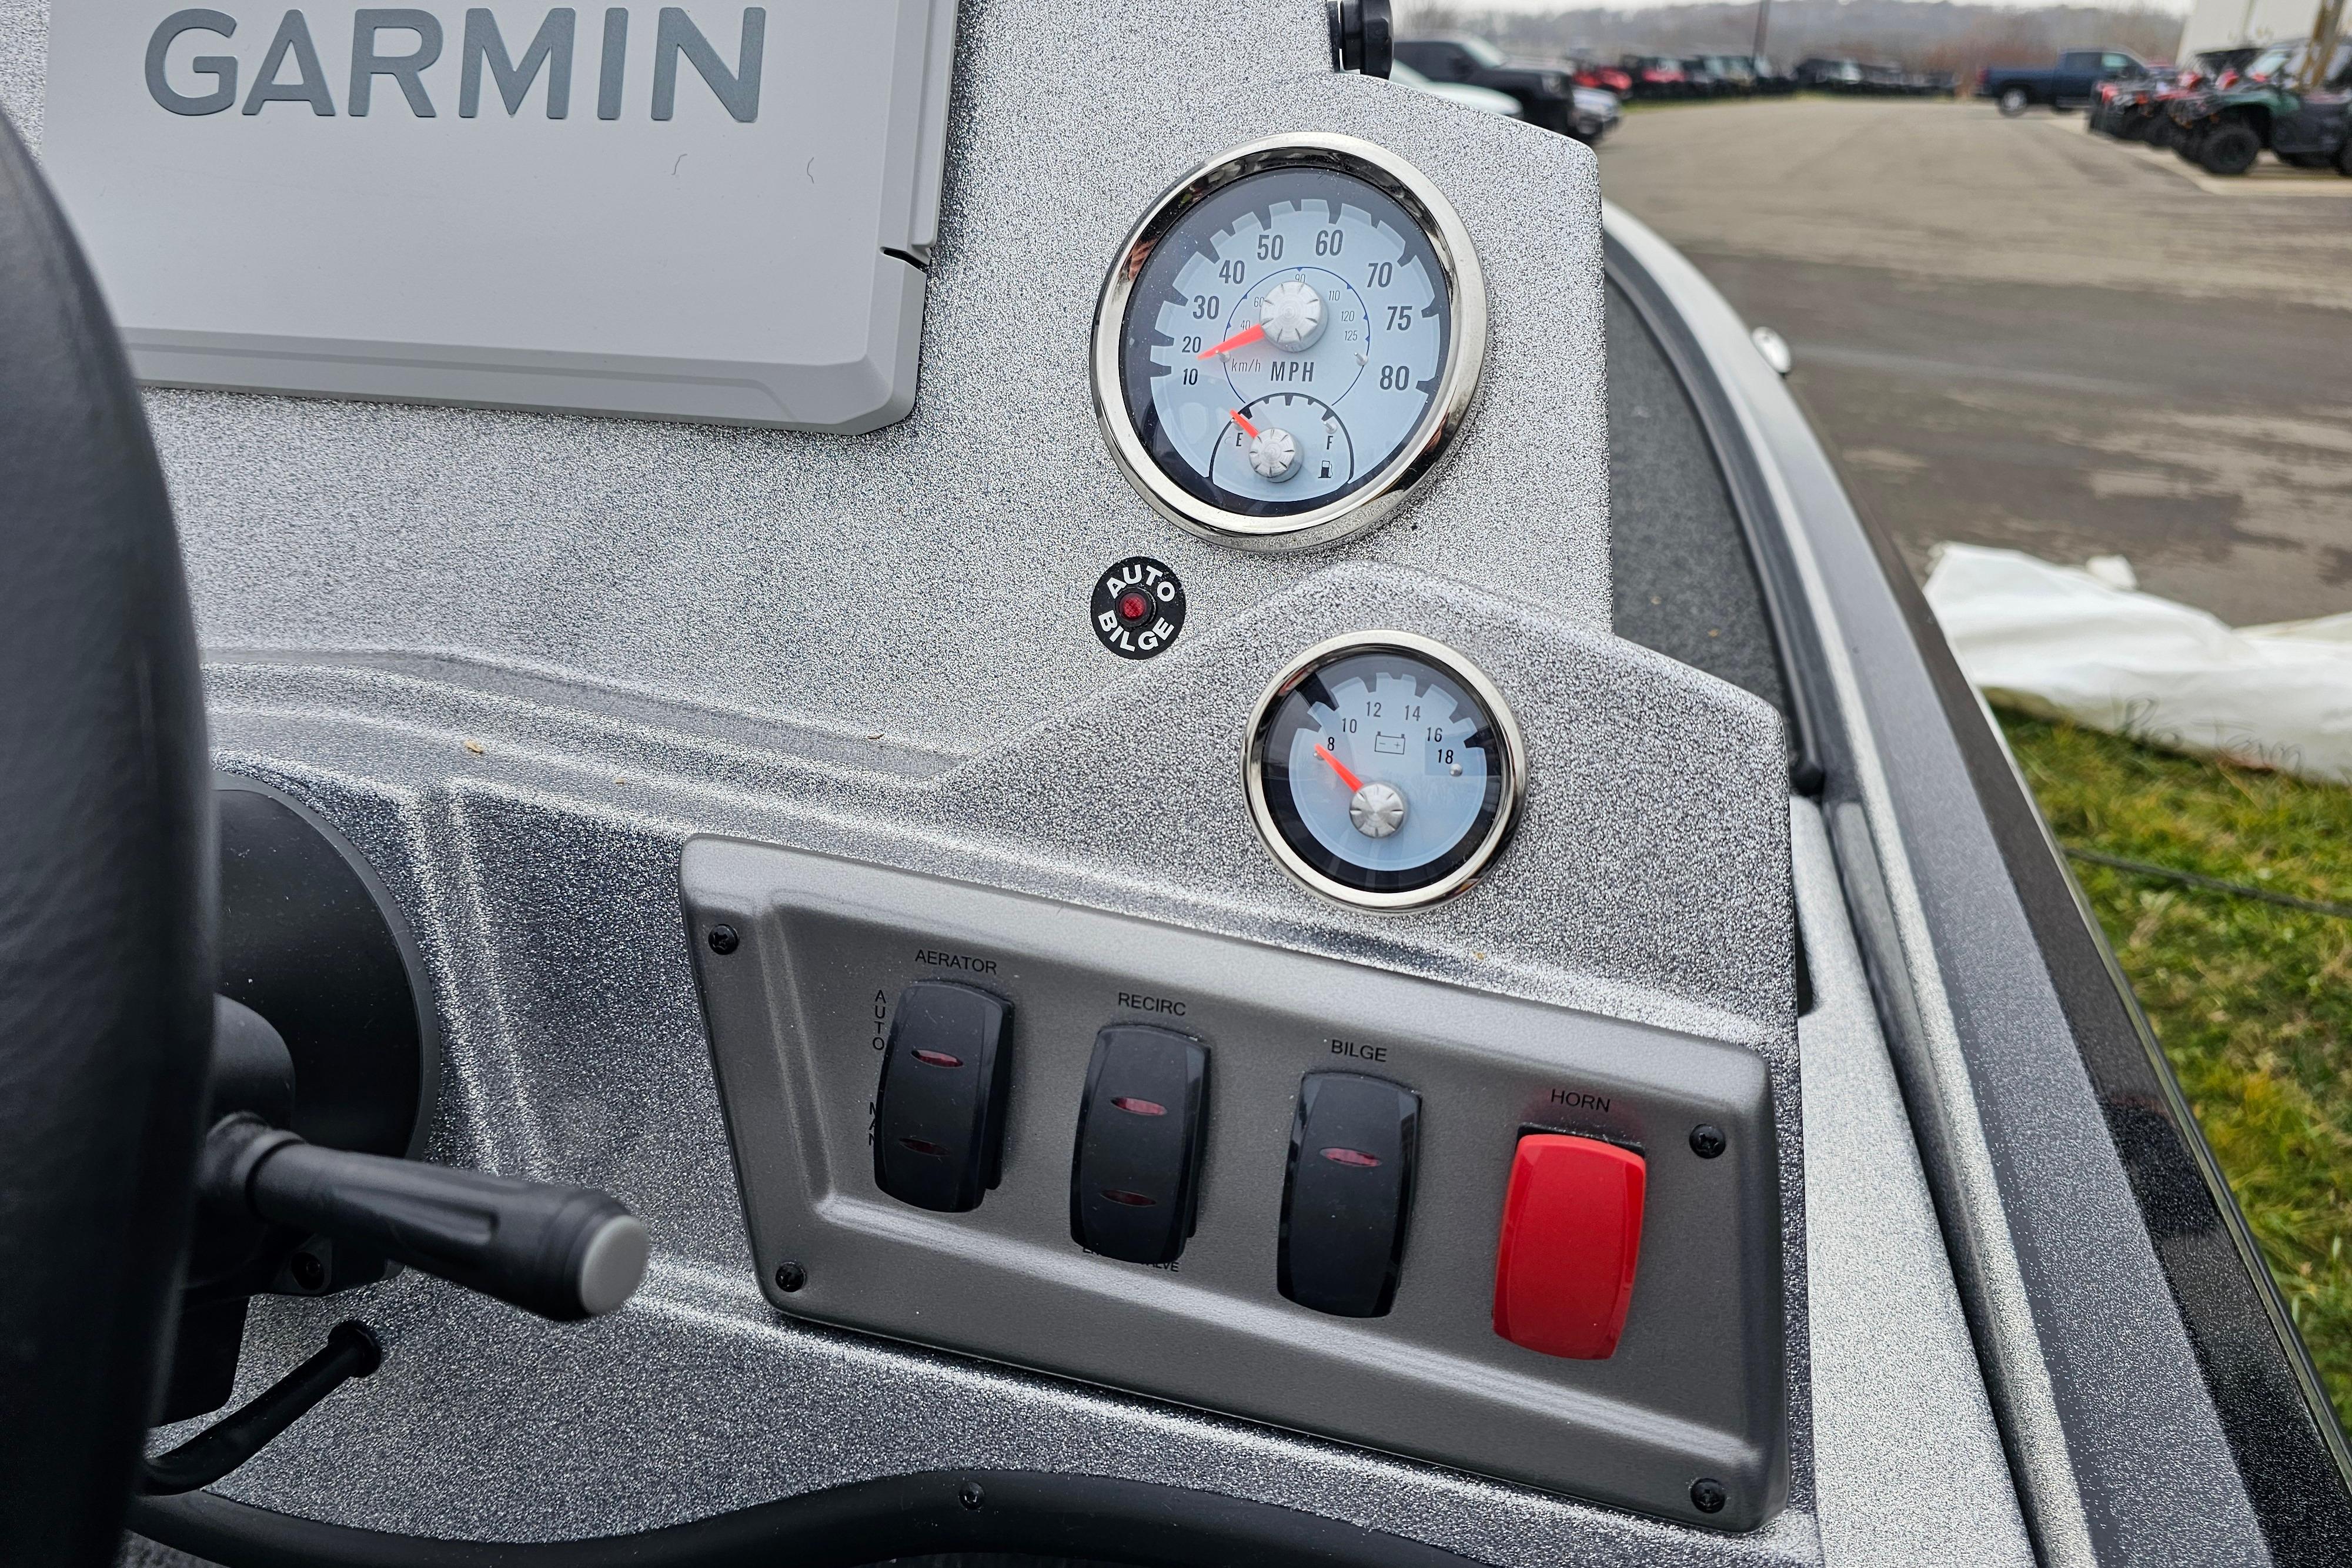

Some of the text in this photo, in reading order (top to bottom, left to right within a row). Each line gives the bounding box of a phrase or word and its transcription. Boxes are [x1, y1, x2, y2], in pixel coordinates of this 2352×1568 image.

[144, 7, 766, 123] GARMIN
[1257, 234, 1284, 261] 50
[1315, 229, 1344, 256] 60
[1219, 260, 1245, 285] 40
[1367, 262, 1392, 288] 70
[1192, 295, 1220, 320] 30
[1328, 290, 1341, 302] 110
[1341, 310, 1355, 322] 120
[1385, 305, 1412, 332] 75
[1181, 336, 1202, 354] 20
[1345, 330, 1358, 342] 125
[1183, 368, 1198, 386] 10
[1231, 358, 1261, 373] km/h
[1270, 360, 1315, 382] MPH
[1379, 365, 1410, 391] 80
[1235, 433, 1243, 447] E
[1327, 435, 1334, 450] F
[1106, 564, 1175, 602] AUTO
[1098, 610, 1175, 652] BILGE
[1366, 701, 1382, 717] 12
[1405, 705, 1421, 721] 14
[1342, 717, 1357, 733] 10
[1426, 727, 1442, 742] 16
[1327, 737, 1335, 751] 8
[1438, 748, 1454, 764] 18
[915, 948, 997, 975] AERATOR
[1118, 992, 1187, 1017] RECIRC
[872, 989, 887, 1051] AUTO
[1331, 1039, 1387, 1063] BILGE
[1551, 1088, 1611, 1113] HORN
